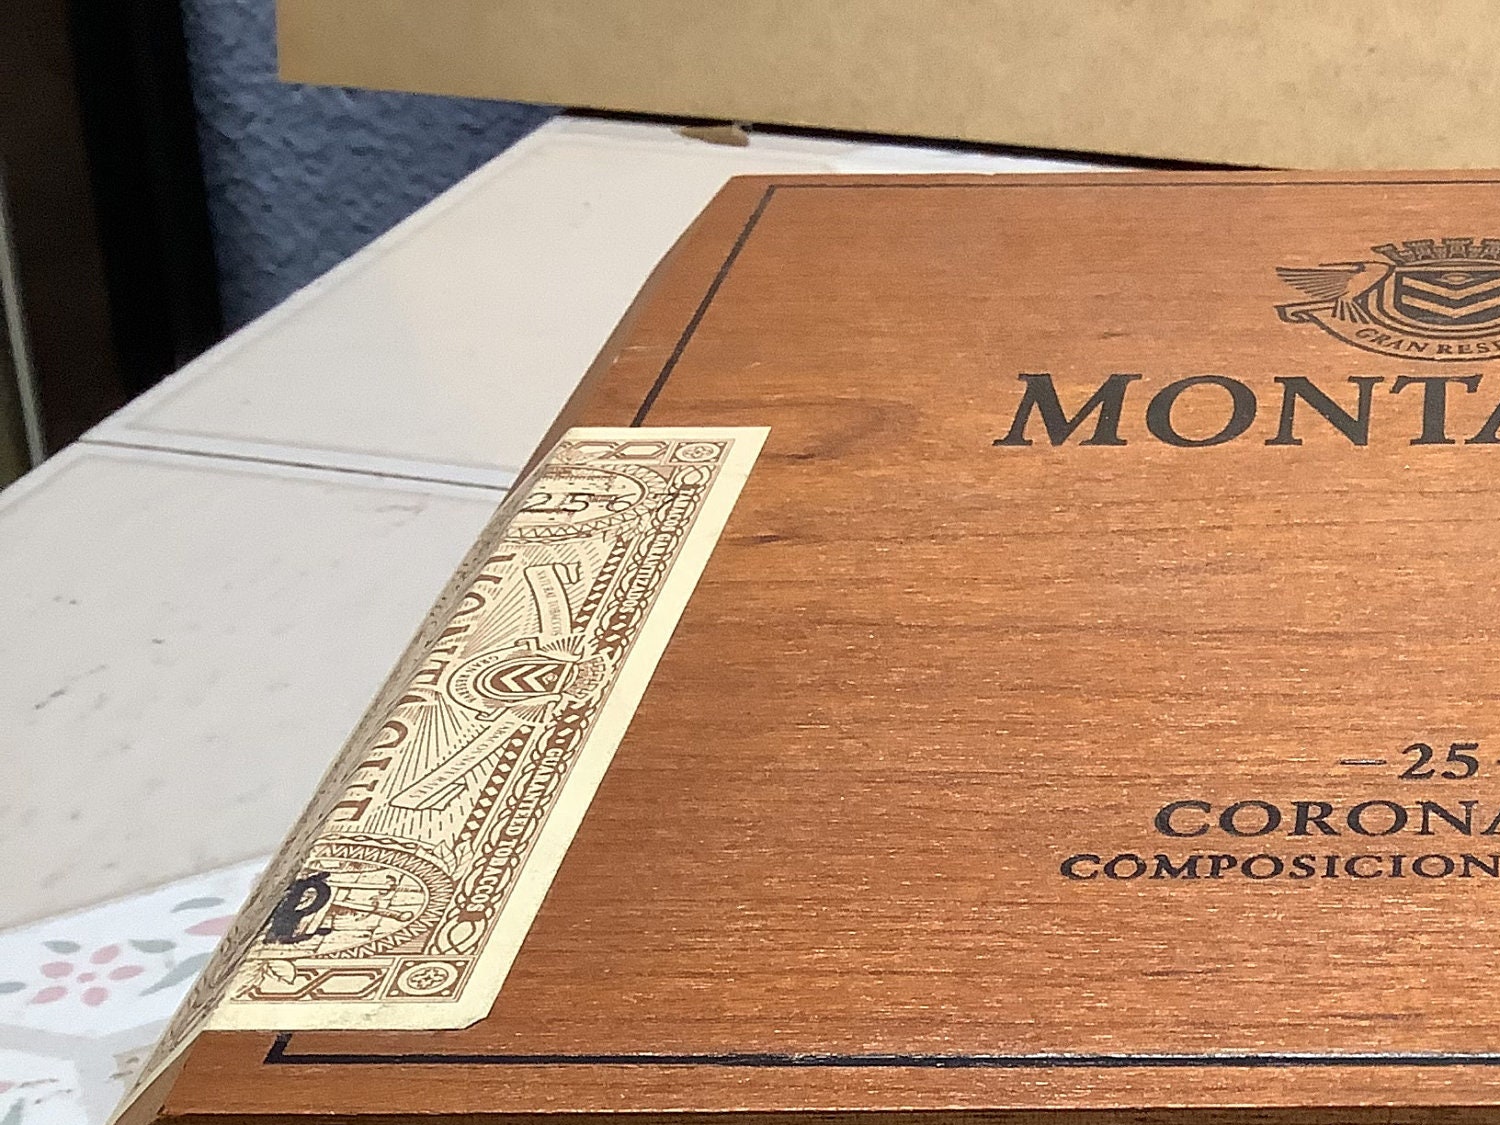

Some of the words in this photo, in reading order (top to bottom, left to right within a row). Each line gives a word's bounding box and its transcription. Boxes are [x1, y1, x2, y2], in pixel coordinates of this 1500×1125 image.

[1355, 327, 1429, 353] GRAN
[620, 532, 673, 613] GARANTIZADOS
[505, 748, 562, 836] GUARANTEED
[466, 839, 520, 912] TOBACCOS
